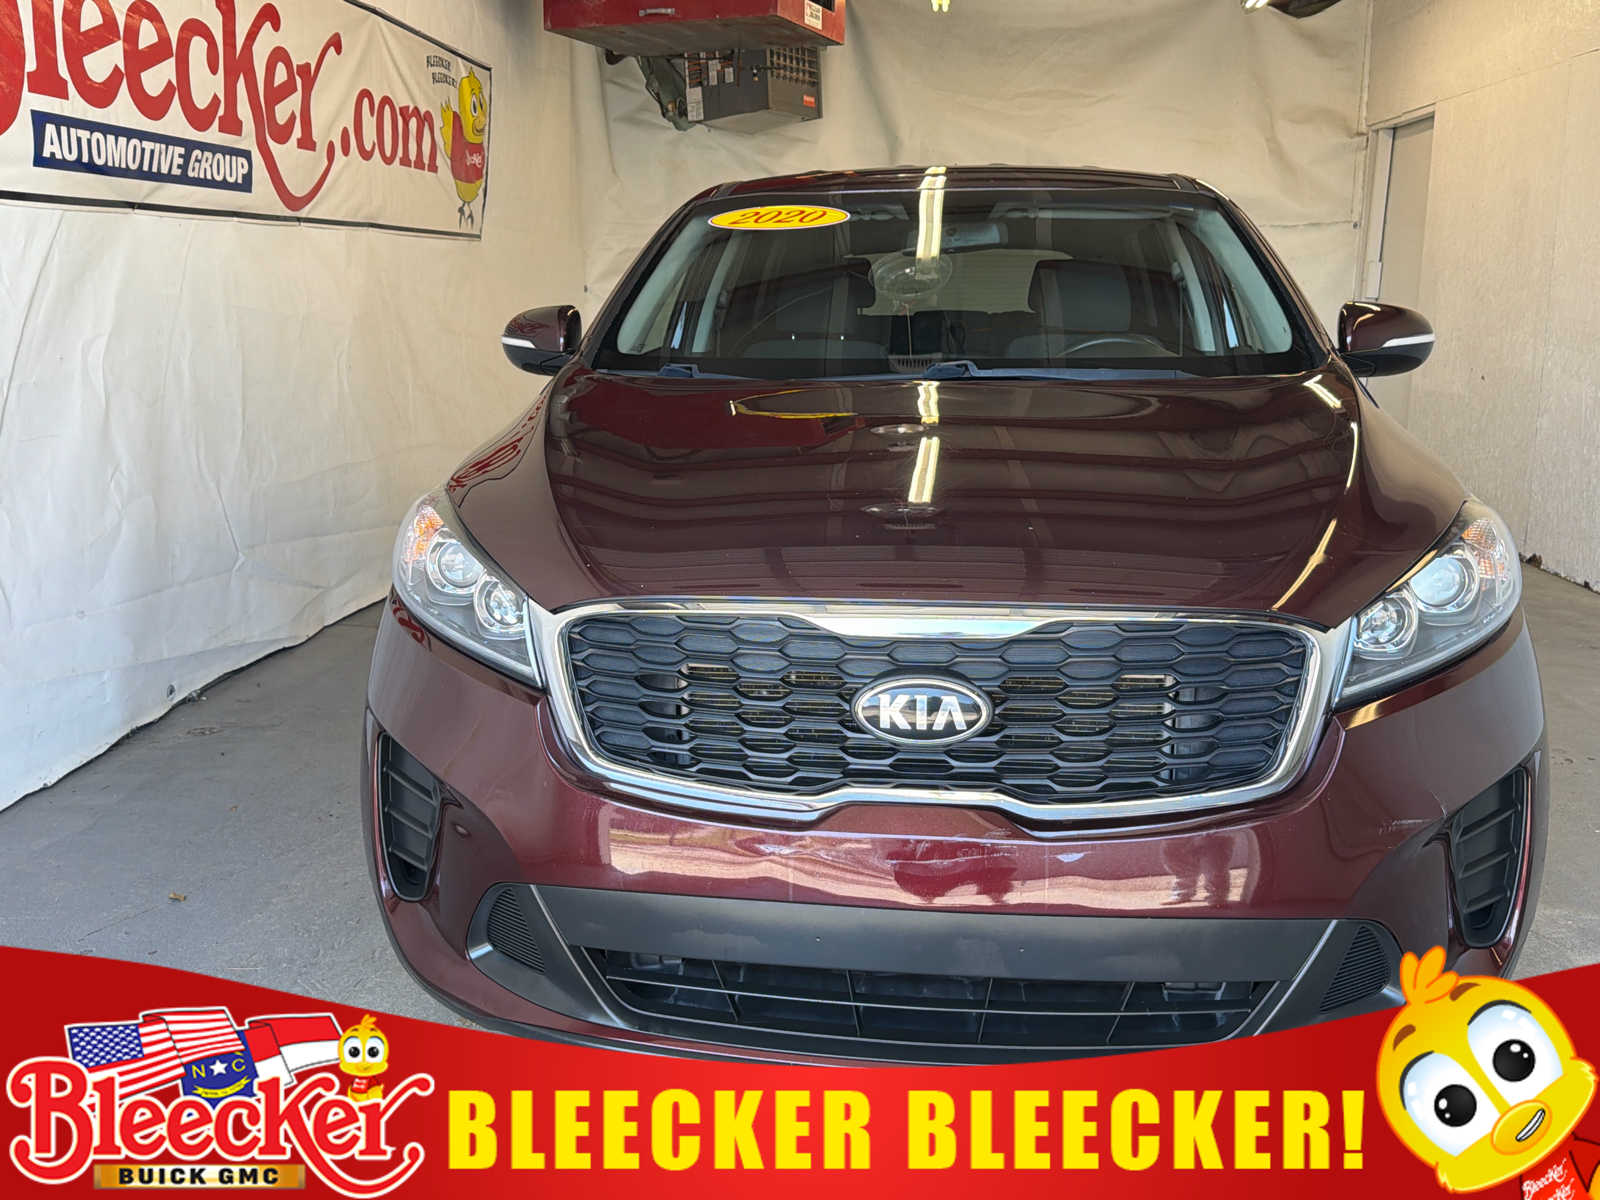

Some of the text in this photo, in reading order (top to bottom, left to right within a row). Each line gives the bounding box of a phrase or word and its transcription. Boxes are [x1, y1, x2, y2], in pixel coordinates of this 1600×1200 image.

[42, 123, 249, 184] AUTOMOTIVE GROUP
[728, 209, 828, 225] 2020
[878, 693, 967, 730] KIA
